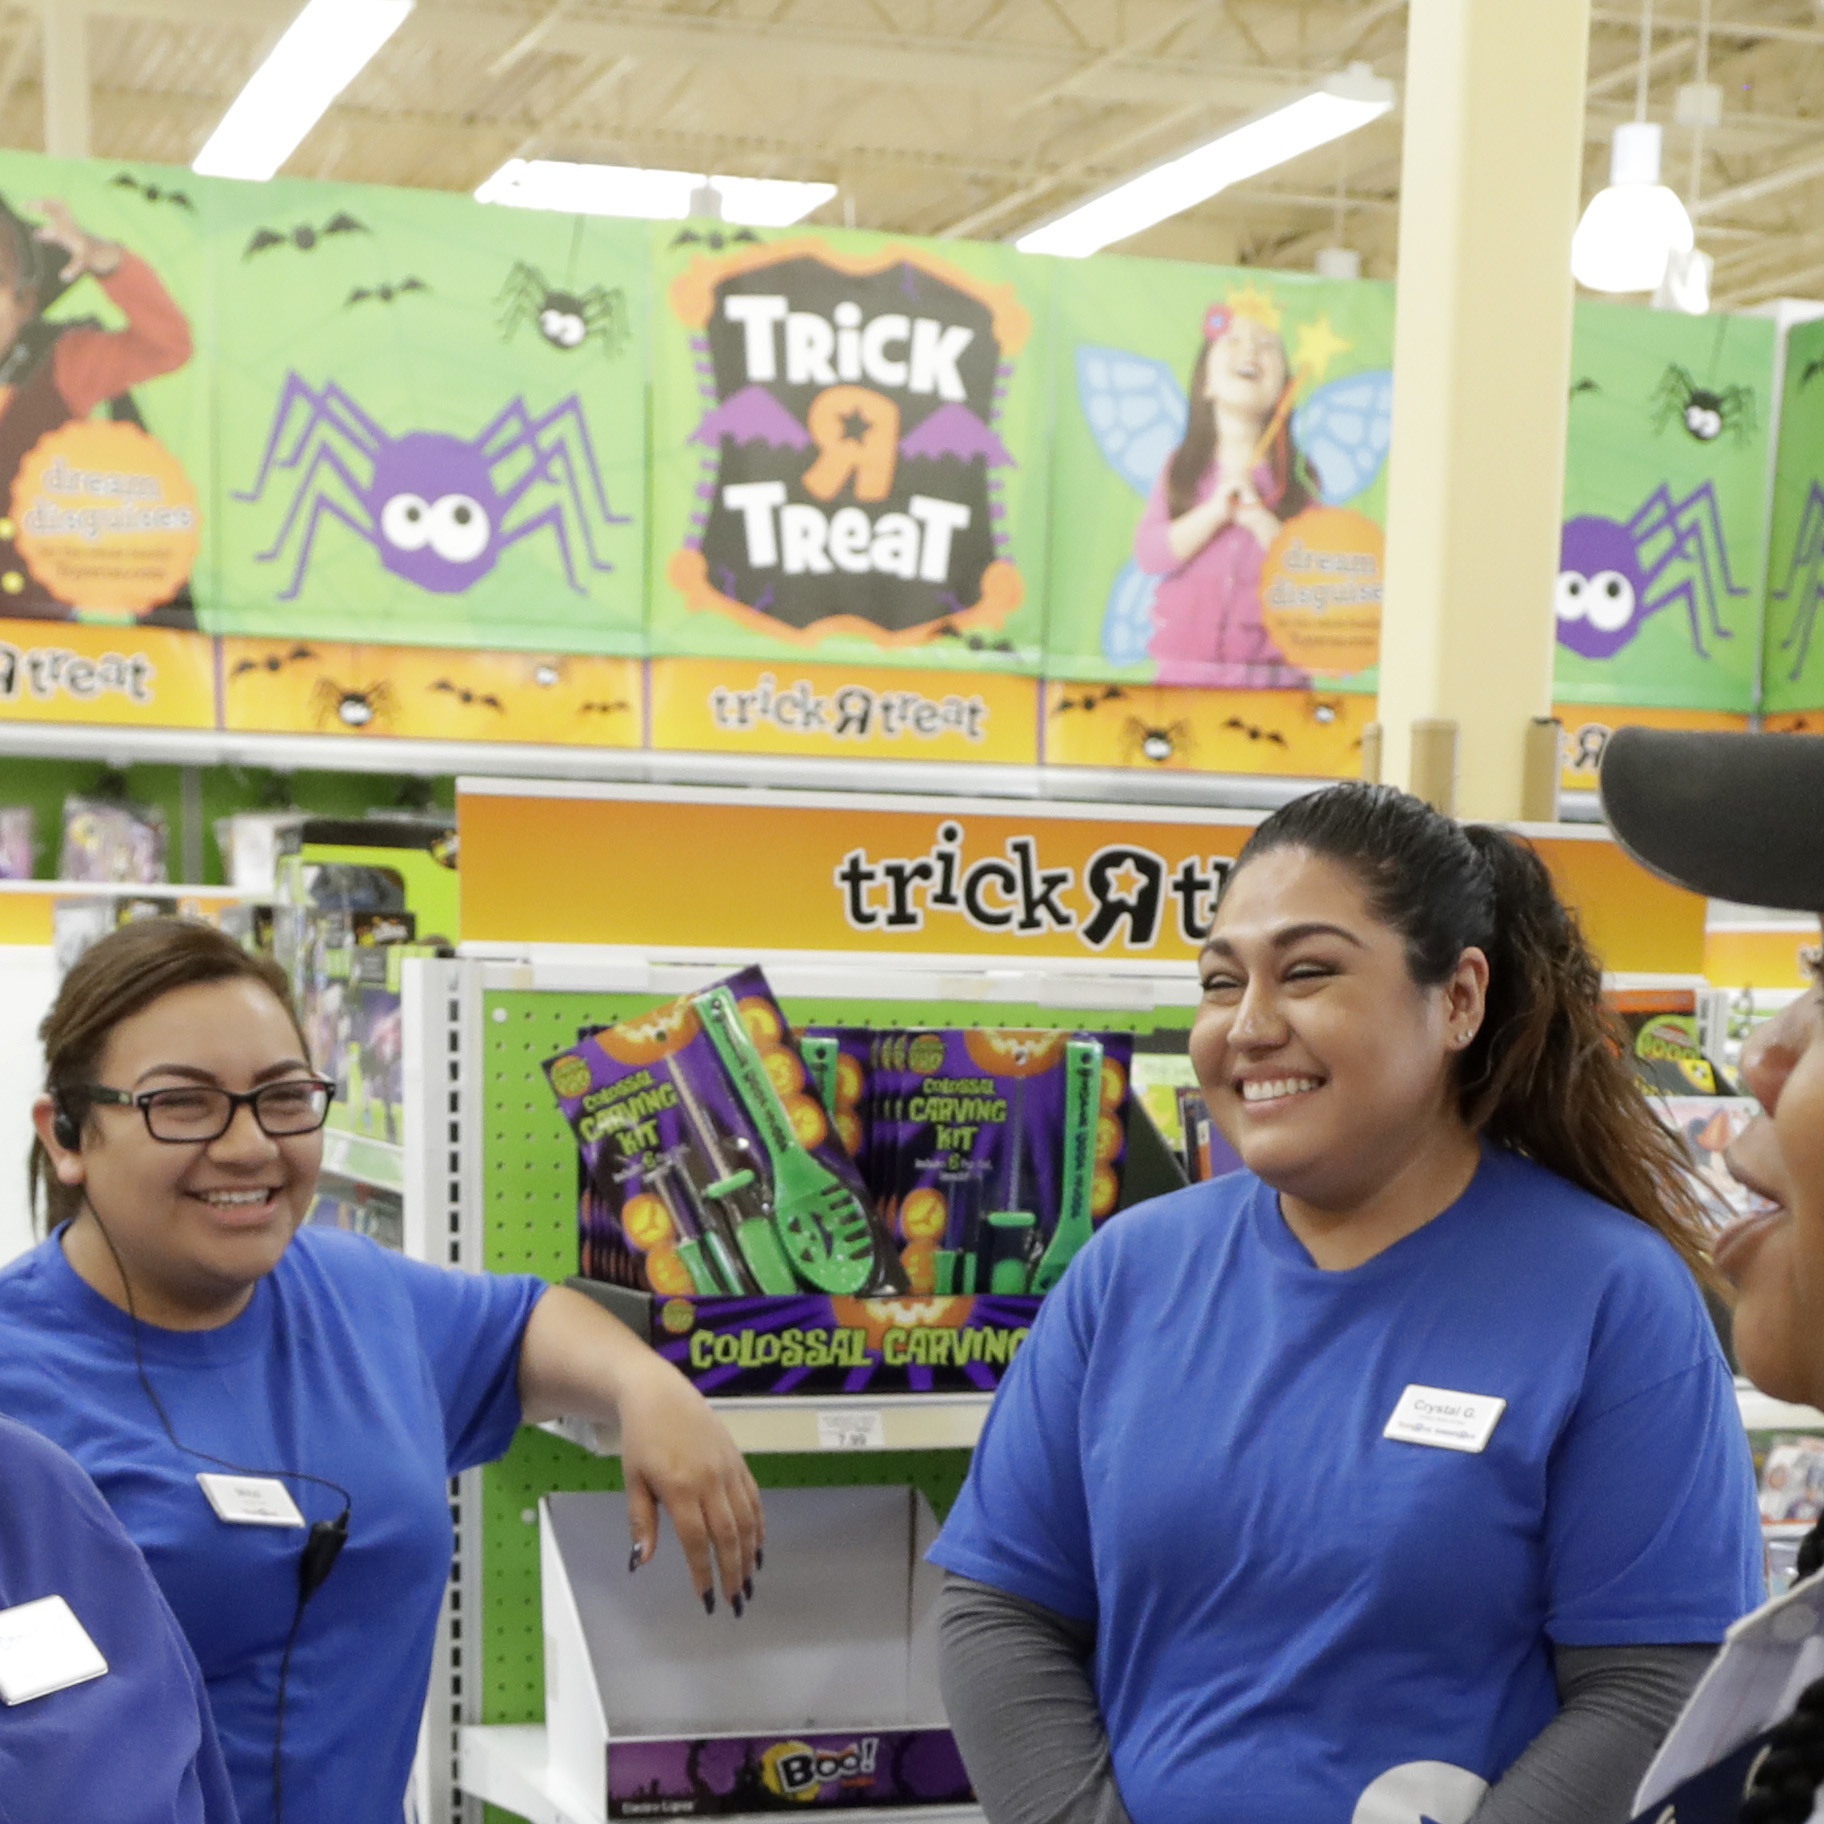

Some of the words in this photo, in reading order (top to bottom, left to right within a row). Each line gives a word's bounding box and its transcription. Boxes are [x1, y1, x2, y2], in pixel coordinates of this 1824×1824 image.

[579, 1082, 677, 1142] CARVING
[908, 1097, 1007, 1122] CARVING
[616, 1118, 659, 1156] KIT
[936, 1124, 978, 1150] KIT
[690, 1328, 872, 1368] COLOSSAL
[1413, 1399, 1461, 1416] Crystal
